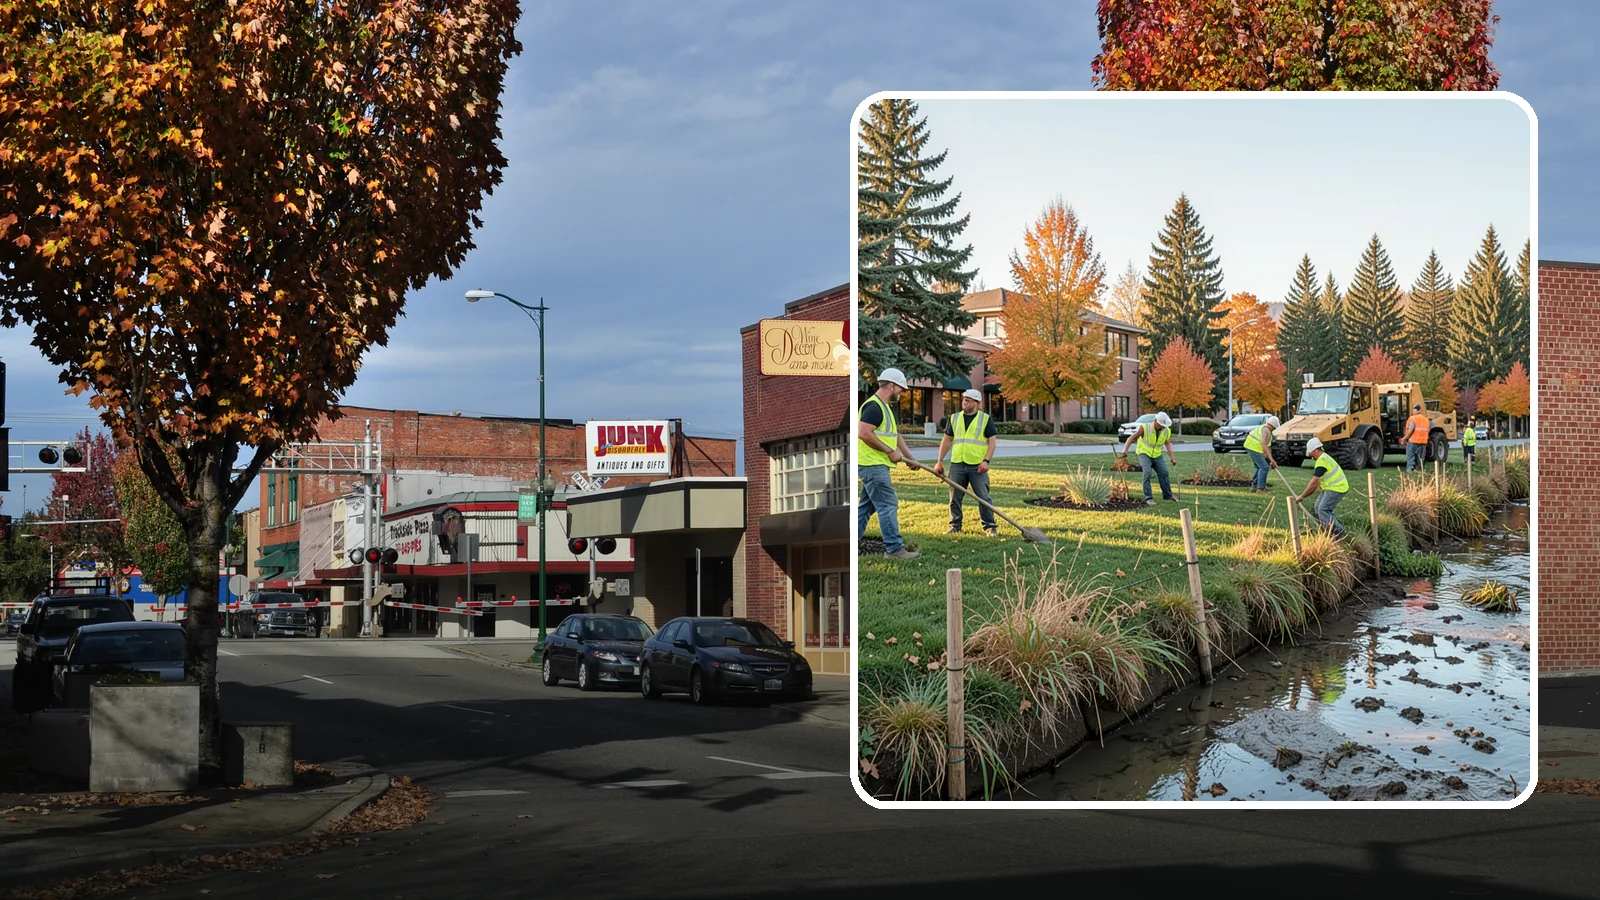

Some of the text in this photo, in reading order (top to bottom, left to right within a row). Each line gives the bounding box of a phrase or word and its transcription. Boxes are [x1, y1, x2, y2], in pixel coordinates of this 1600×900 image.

[595, 425, 666, 457] JUNK
[607, 446, 646, 454] DISORDERLY
[597, 460, 665, 470] ANTIQUES AND GIFTS
[573, 473, 588, 490] RAIL
[590, 476, 608, 491] SING
[414, 519, 429, 535] Pizza
